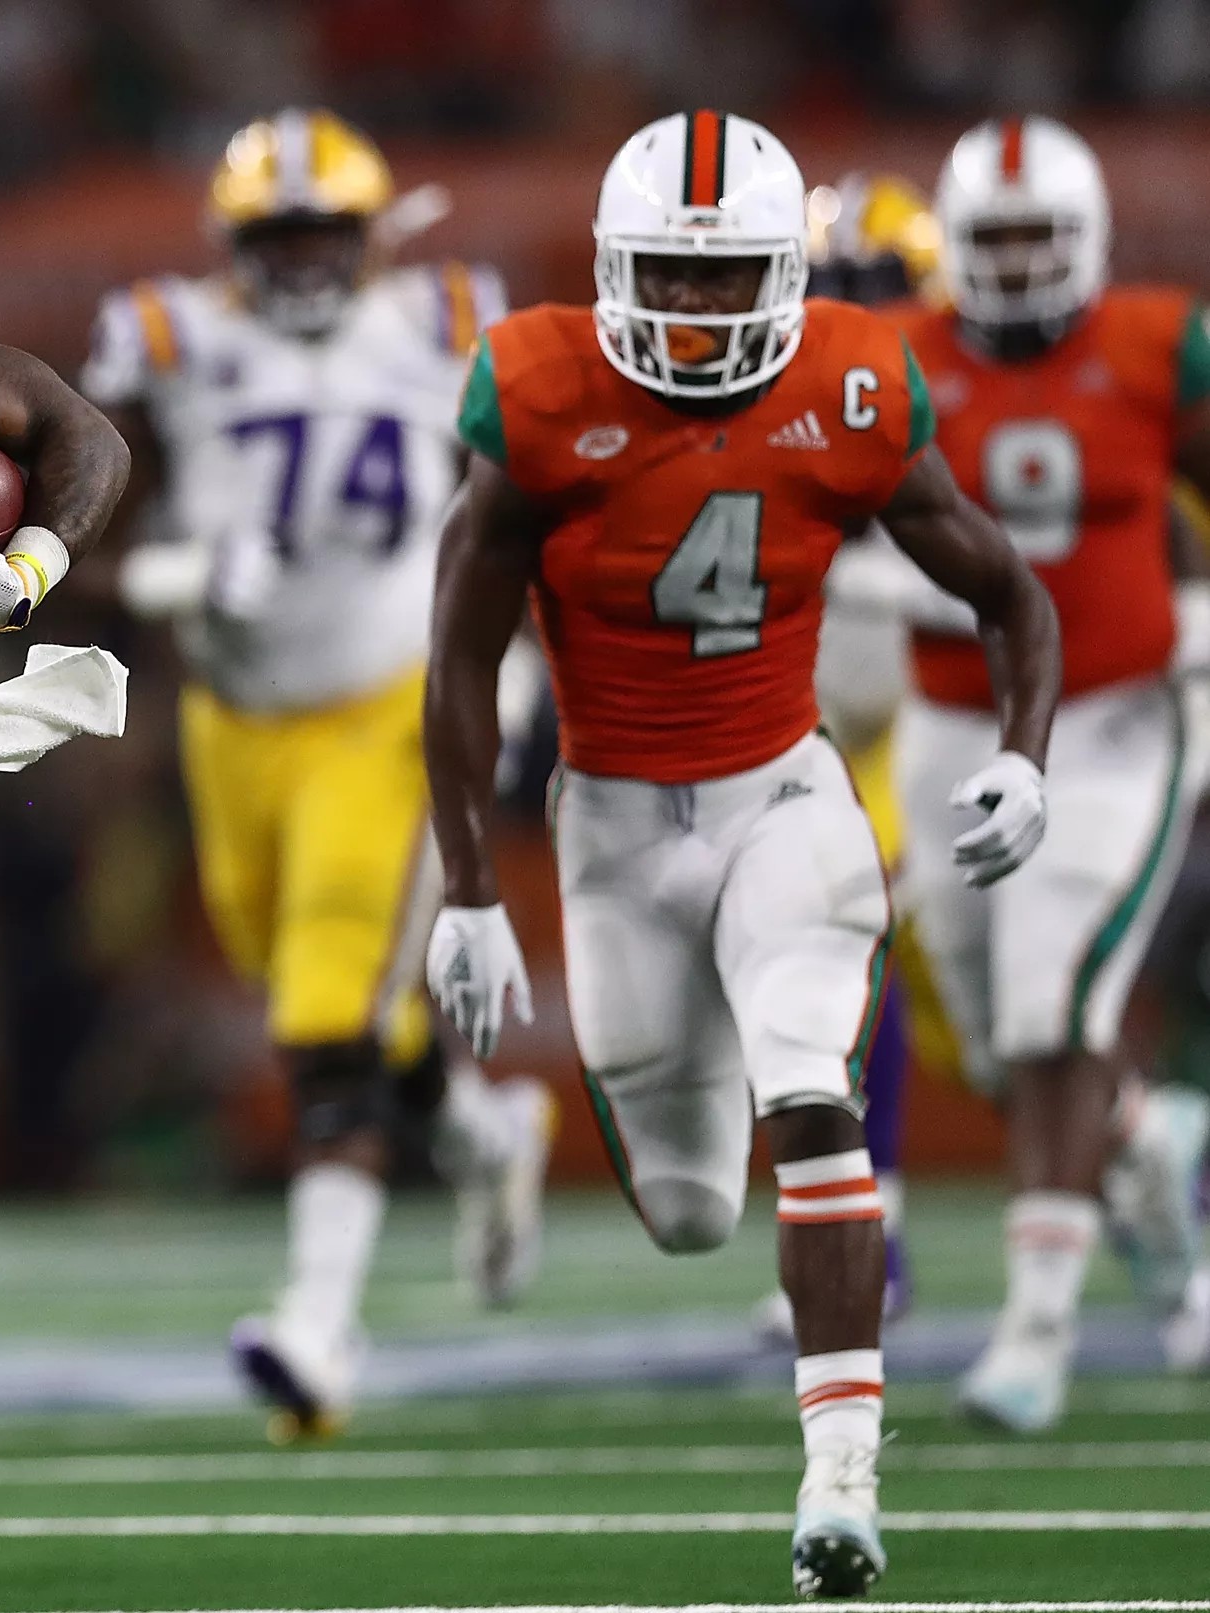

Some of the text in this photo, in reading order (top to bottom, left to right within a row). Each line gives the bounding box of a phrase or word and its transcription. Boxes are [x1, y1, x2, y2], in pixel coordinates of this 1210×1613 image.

[843, 366, 879, 431] C
[225, 412, 412, 566] 74
[982, 417, 1084, 564] 9
[652, 491, 768, 657] 4
